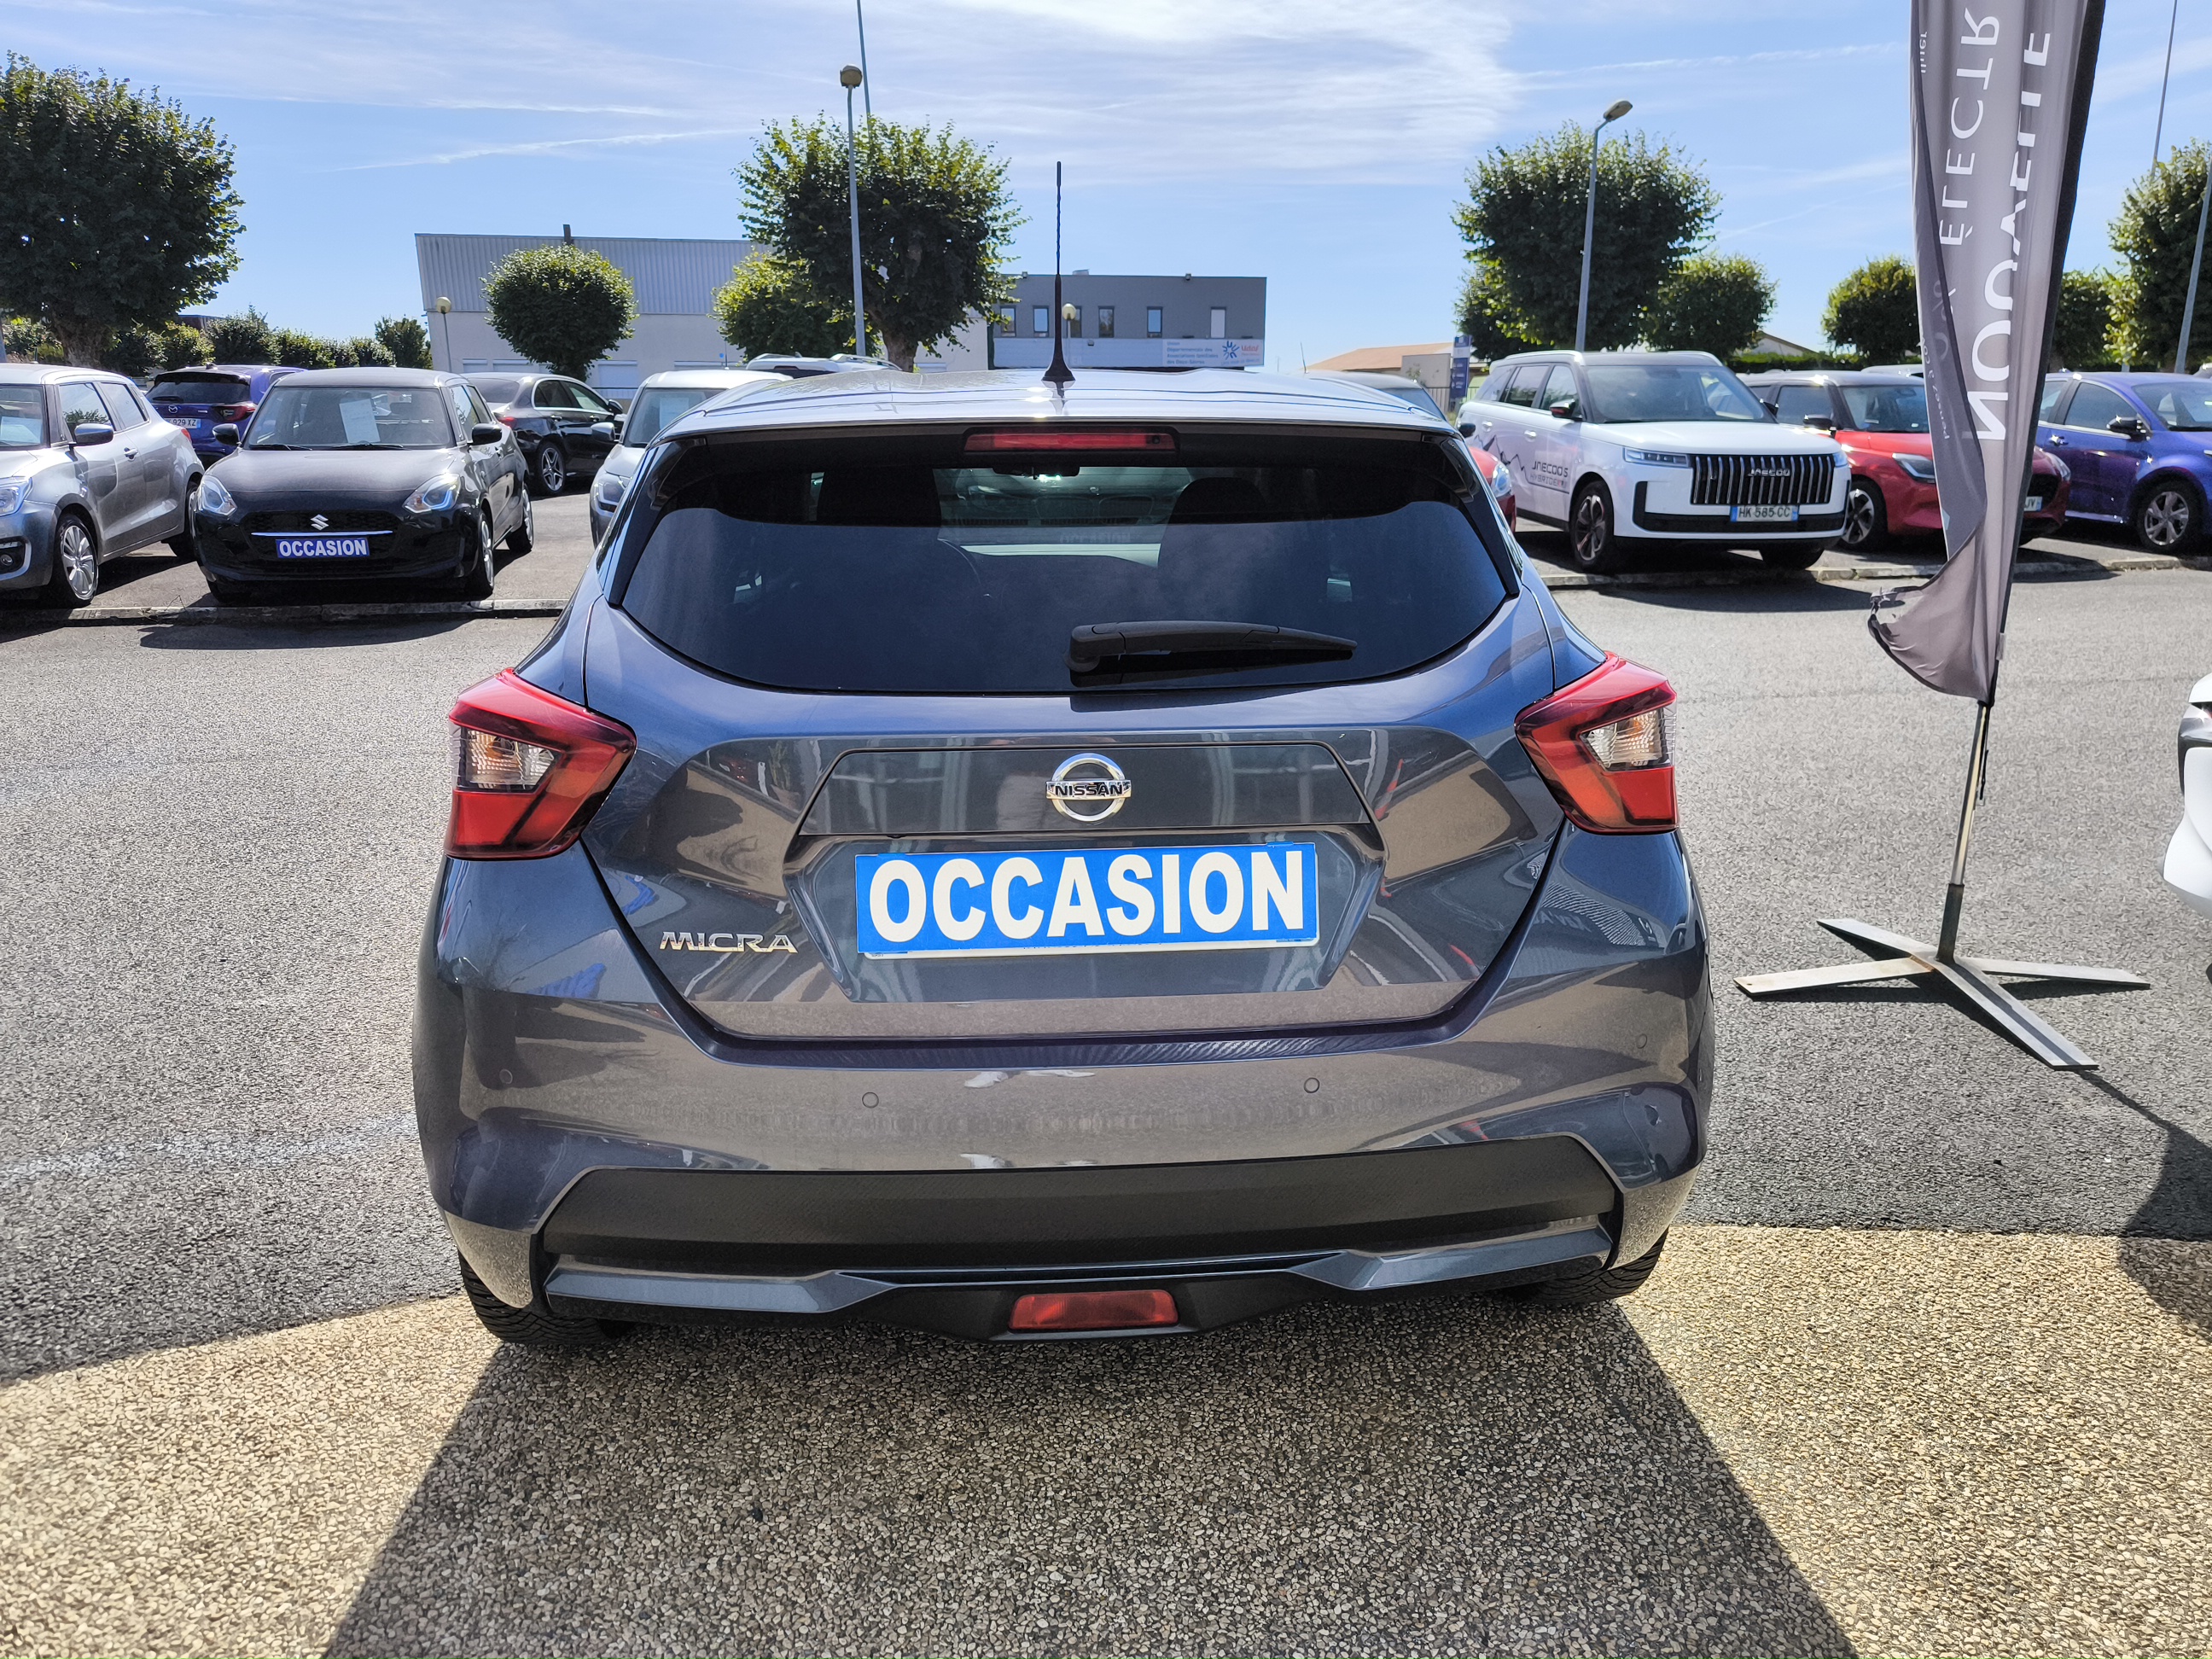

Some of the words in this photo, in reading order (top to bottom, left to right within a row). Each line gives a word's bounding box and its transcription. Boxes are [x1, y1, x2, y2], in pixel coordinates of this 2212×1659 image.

[279, 539, 367, 557] OCCASION
[1055, 784, 1123, 796] NISSAN
[869, 850, 1304, 943] OCCASION
[659, 931, 799, 954] MICRA
